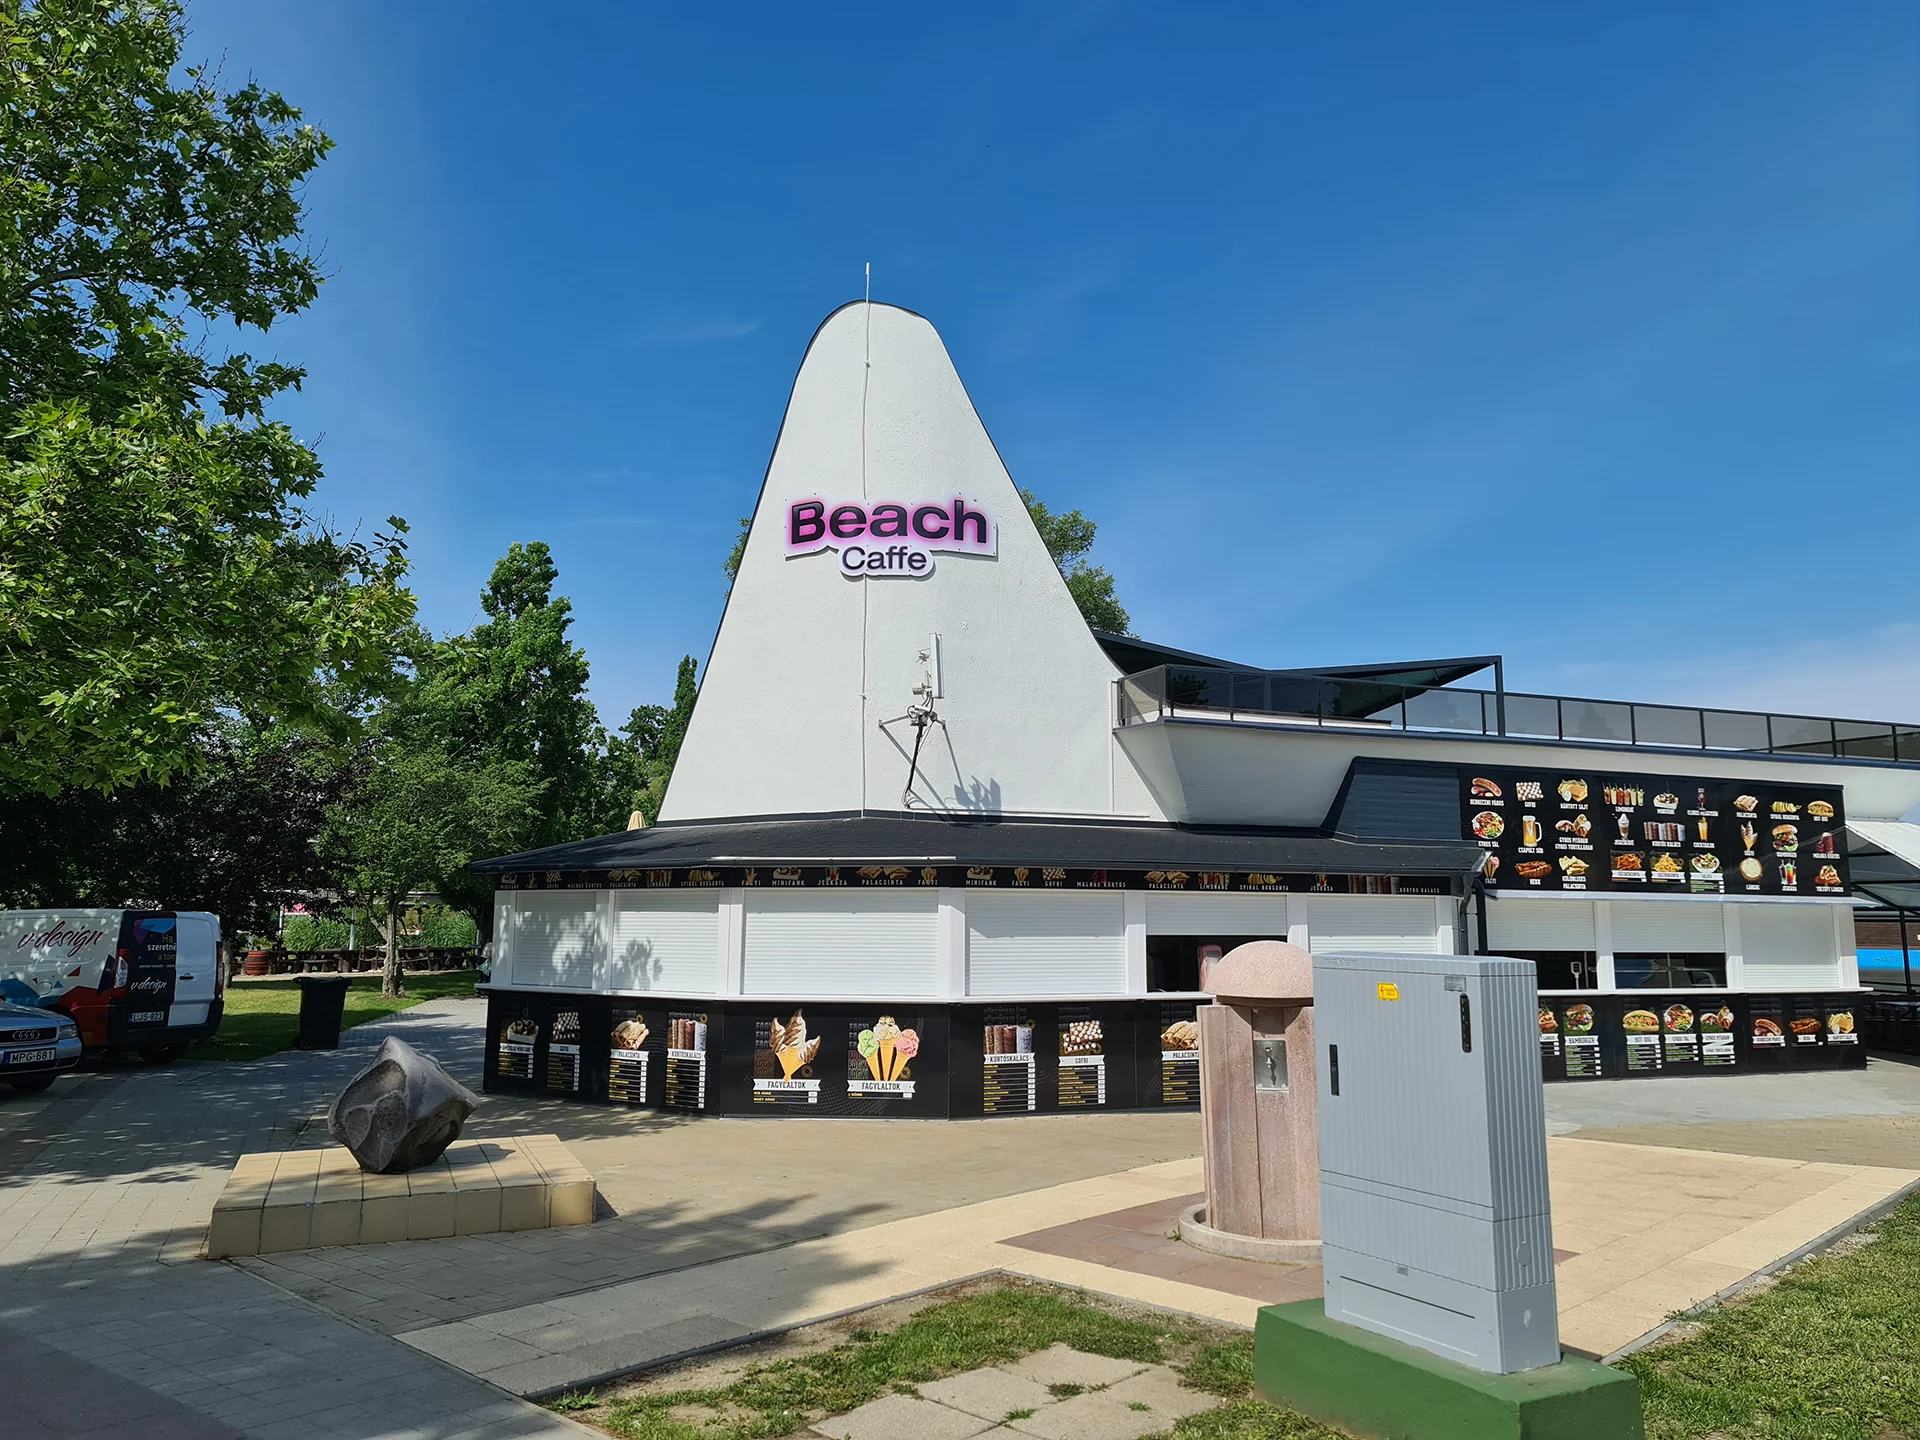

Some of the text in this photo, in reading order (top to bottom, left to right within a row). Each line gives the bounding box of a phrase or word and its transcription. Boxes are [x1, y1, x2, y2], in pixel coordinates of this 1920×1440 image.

[791, 499, 987, 545] Beach
[842, 546, 927, 570] Caffe
[162, 933, 173, 943] Ha
[134, 1013, 162, 1021] LJS-823
[12, 1050, 52, 1063] MPG-681
[861, 1082, 901, 1090] FAGYLALTOK
